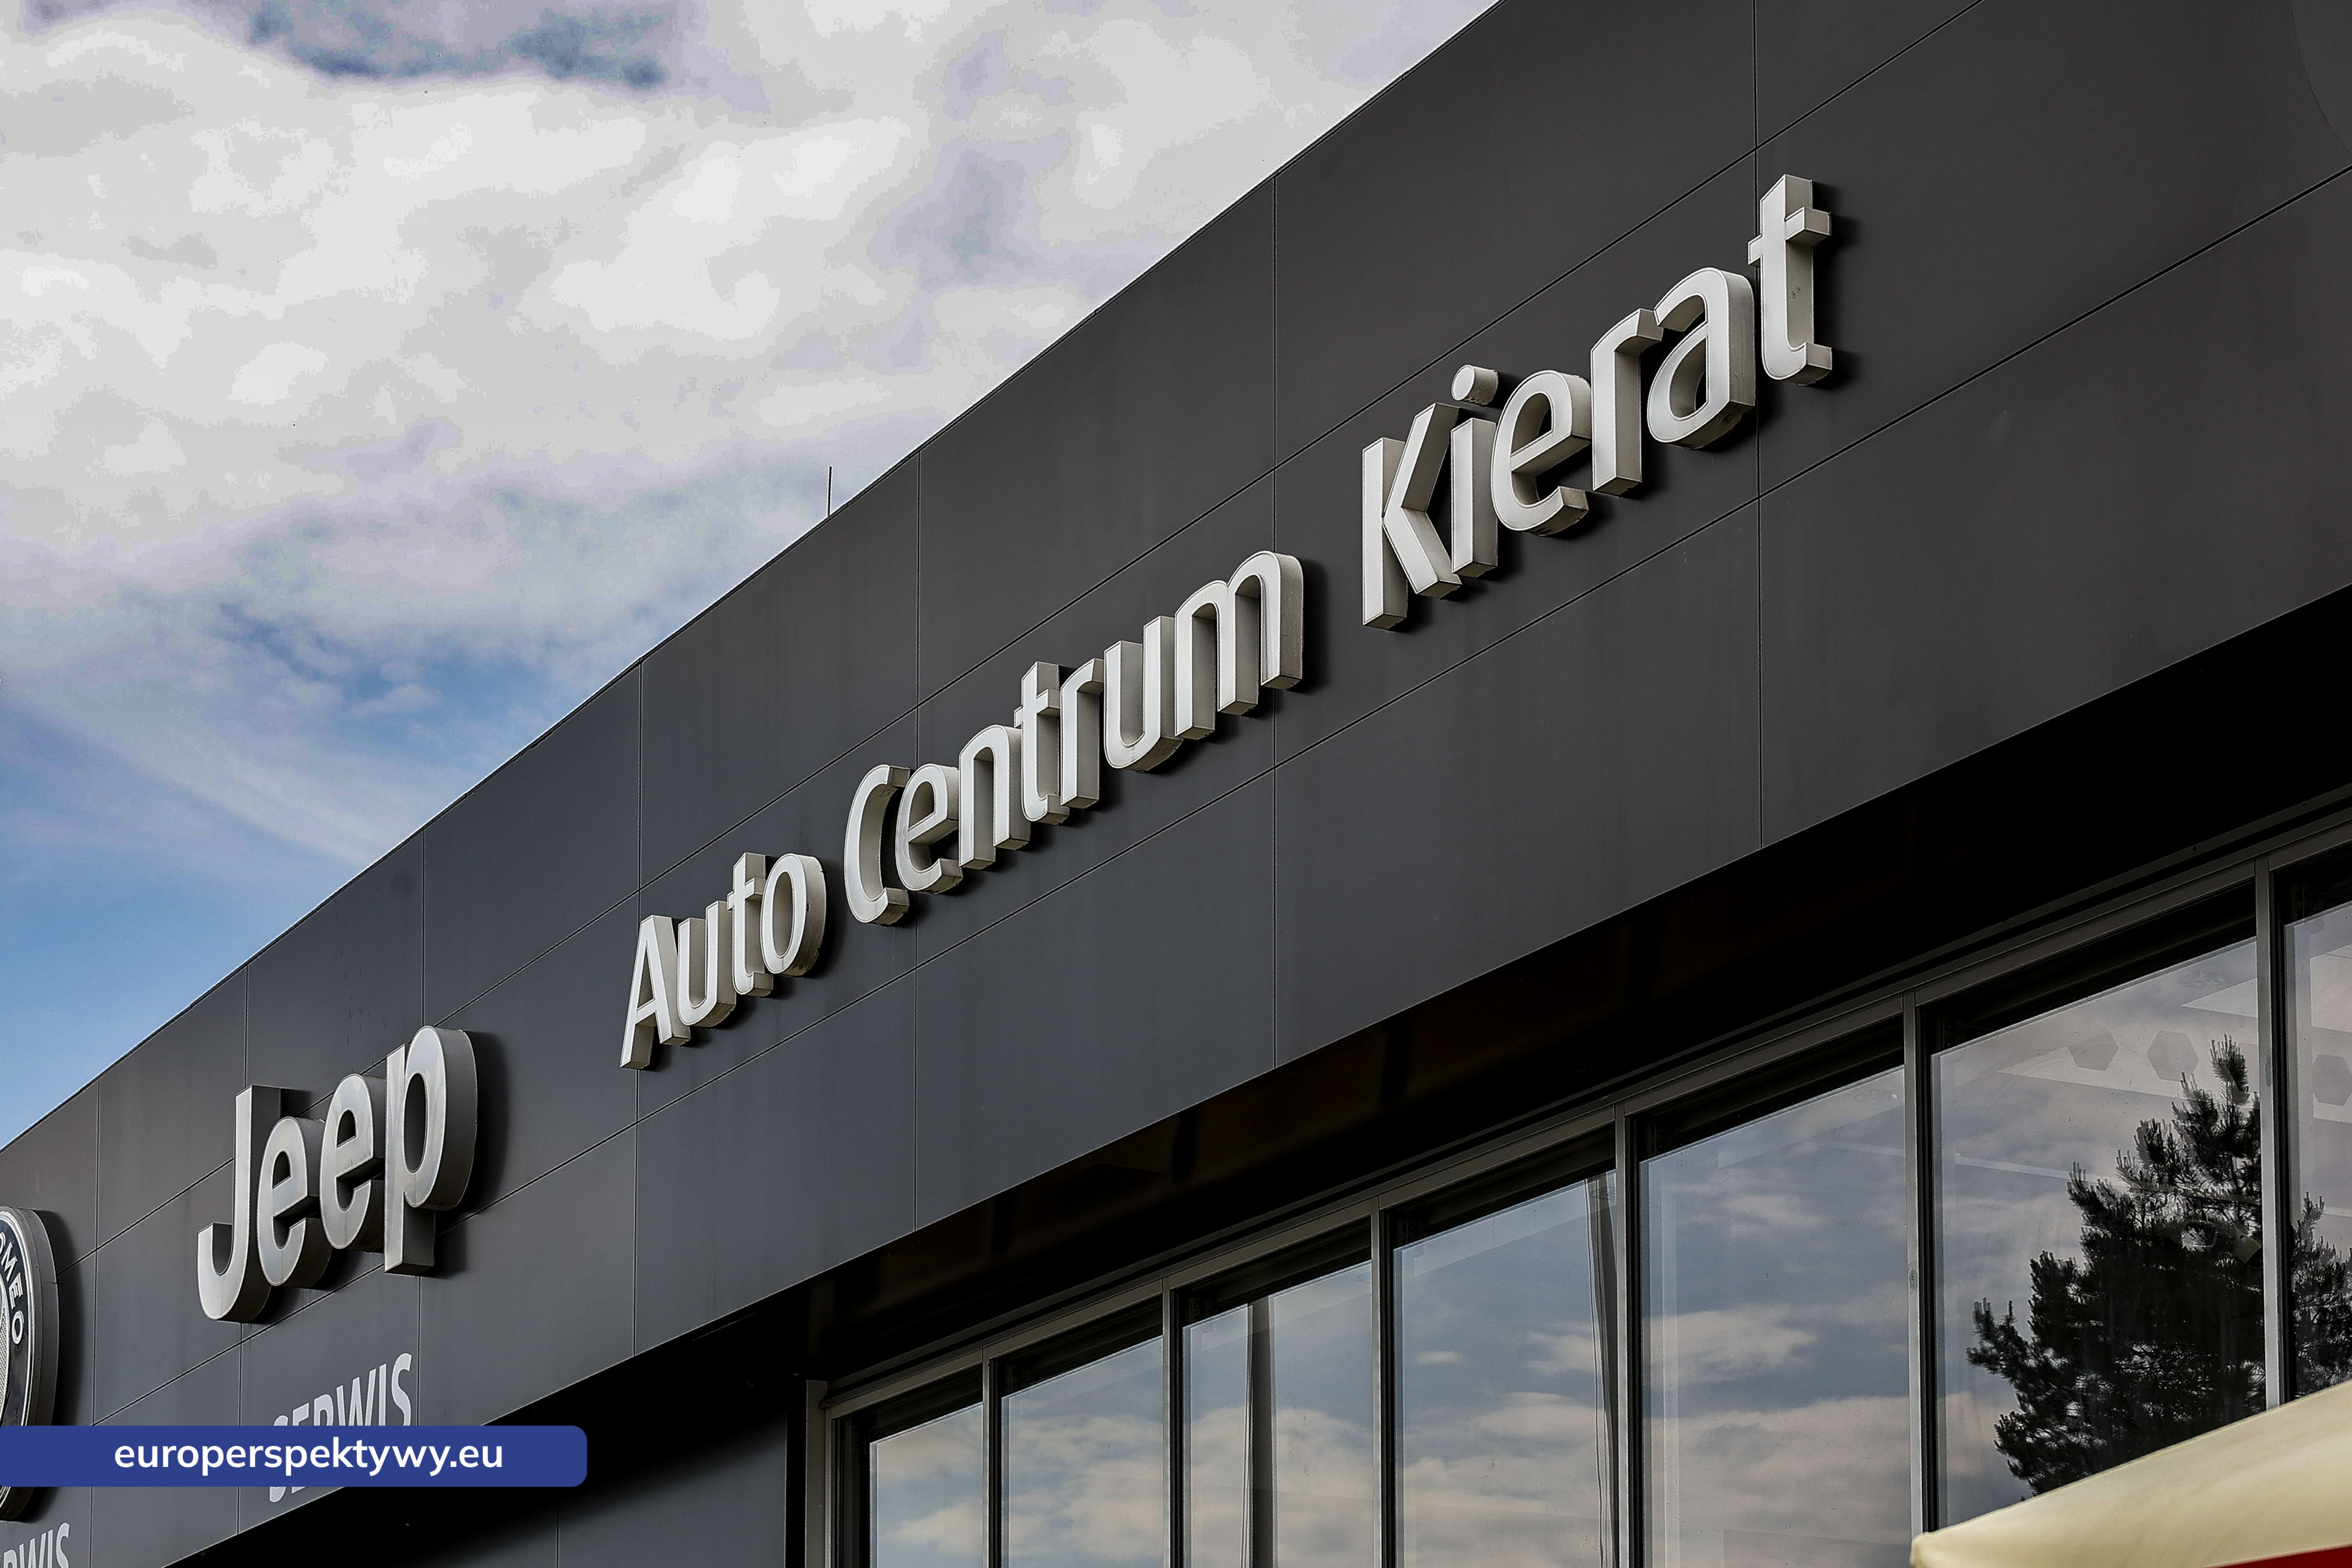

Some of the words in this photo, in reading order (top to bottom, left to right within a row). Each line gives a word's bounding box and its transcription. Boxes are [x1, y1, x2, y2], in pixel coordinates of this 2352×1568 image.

[620, 852, 827, 1069] Auto
[844, 551, 1303, 925] Centrum
[1362, 174, 1832, 630] Kierat
[197, 1025, 477, 1323] Jeep
